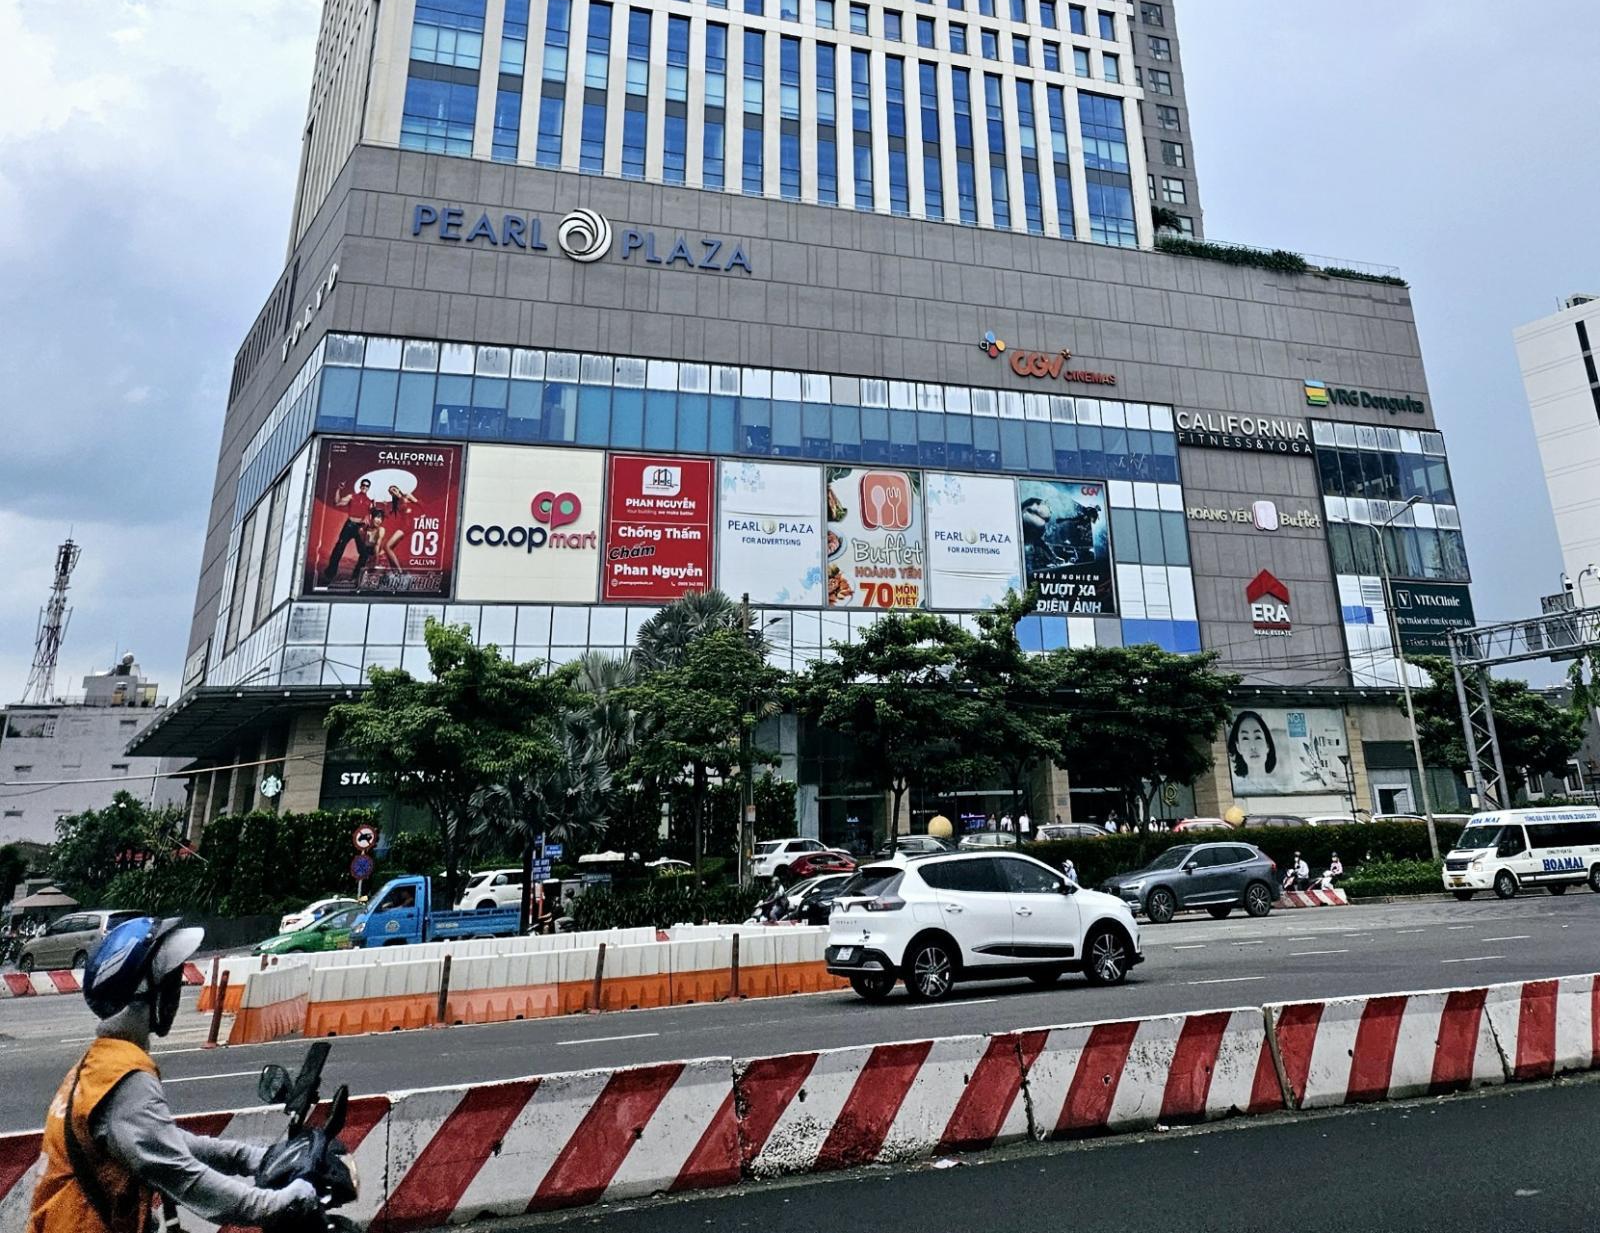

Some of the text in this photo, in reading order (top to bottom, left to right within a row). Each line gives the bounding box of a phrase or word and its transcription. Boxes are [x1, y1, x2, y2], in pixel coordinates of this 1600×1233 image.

[412, 204, 752, 274] PEARL PLAZA
[1009, 350, 1117, 386] CGV CINEMAS
[1327, 387, 1359, 407] VRG
[1176, 411, 1309, 441] CALIFORNIA
[378, 451, 445, 463] CALIFORNIA
[1080, 486, 1101, 497] CGV
[625, 498, 653, 508] PHAN
[1186, 505, 1229, 522] HOÀNG
[1279, 510, 1321, 528] Buffet
[618, 525, 701, 541] Chống Thấm
[728, 520, 814, 534] PEARL PLAZA
[410, 531, 439, 556] 03
[466, 525, 597, 554] co.op mart
[757, 537, 801, 546] ADVERTISING
[934, 530, 1011, 544] PEARL PLAZA
[851, 533, 923, 565] Buffet
[961, 547, 1000, 555] ADVERTISING
[614, 562, 703, 579] Phan Nguyễn
[855, 565, 896, 579] HOÀNG
[859, 582, 894, 608] 70
[1078, 584, 1097, 596] XA
[1251, 603, 1290, 623] ERA
